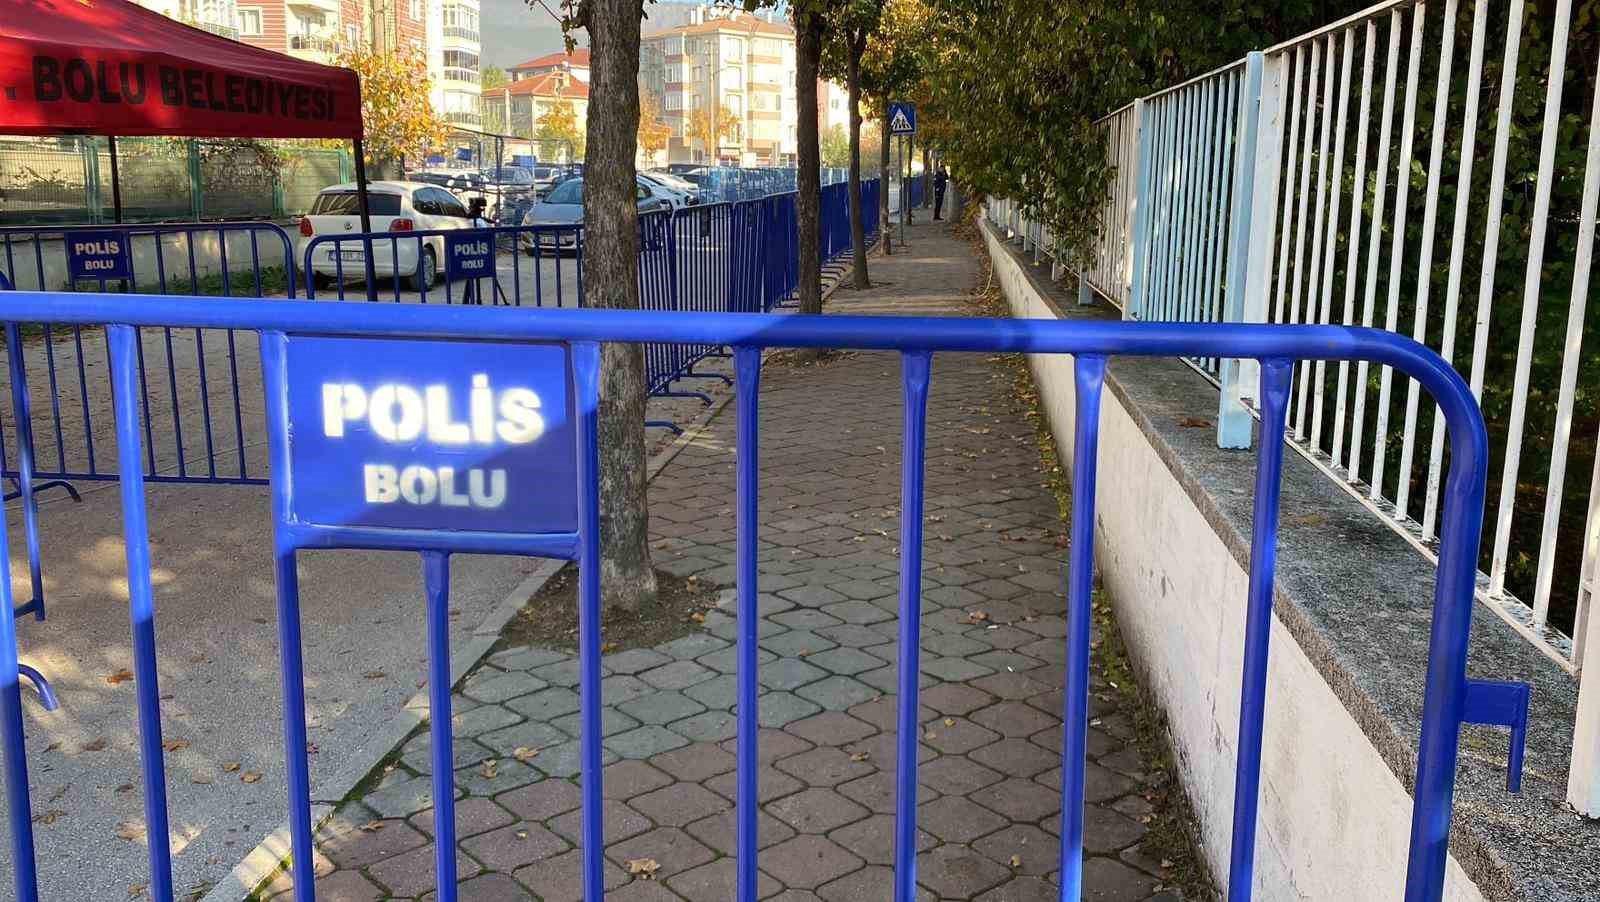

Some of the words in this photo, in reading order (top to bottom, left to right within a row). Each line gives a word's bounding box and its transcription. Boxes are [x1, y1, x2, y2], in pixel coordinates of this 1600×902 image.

[33, 55, 146, 104] BOLU
[160, 64, 336, 121] BELEDİYESİ
[75, 240, 120, 255] POLİS
[455, 240, 488, 256] POLİS
[85, 259, 114, 270] BOLU
[321, 373, 544, 444] POLİS
[364, 463, 507, 508] BOLU
